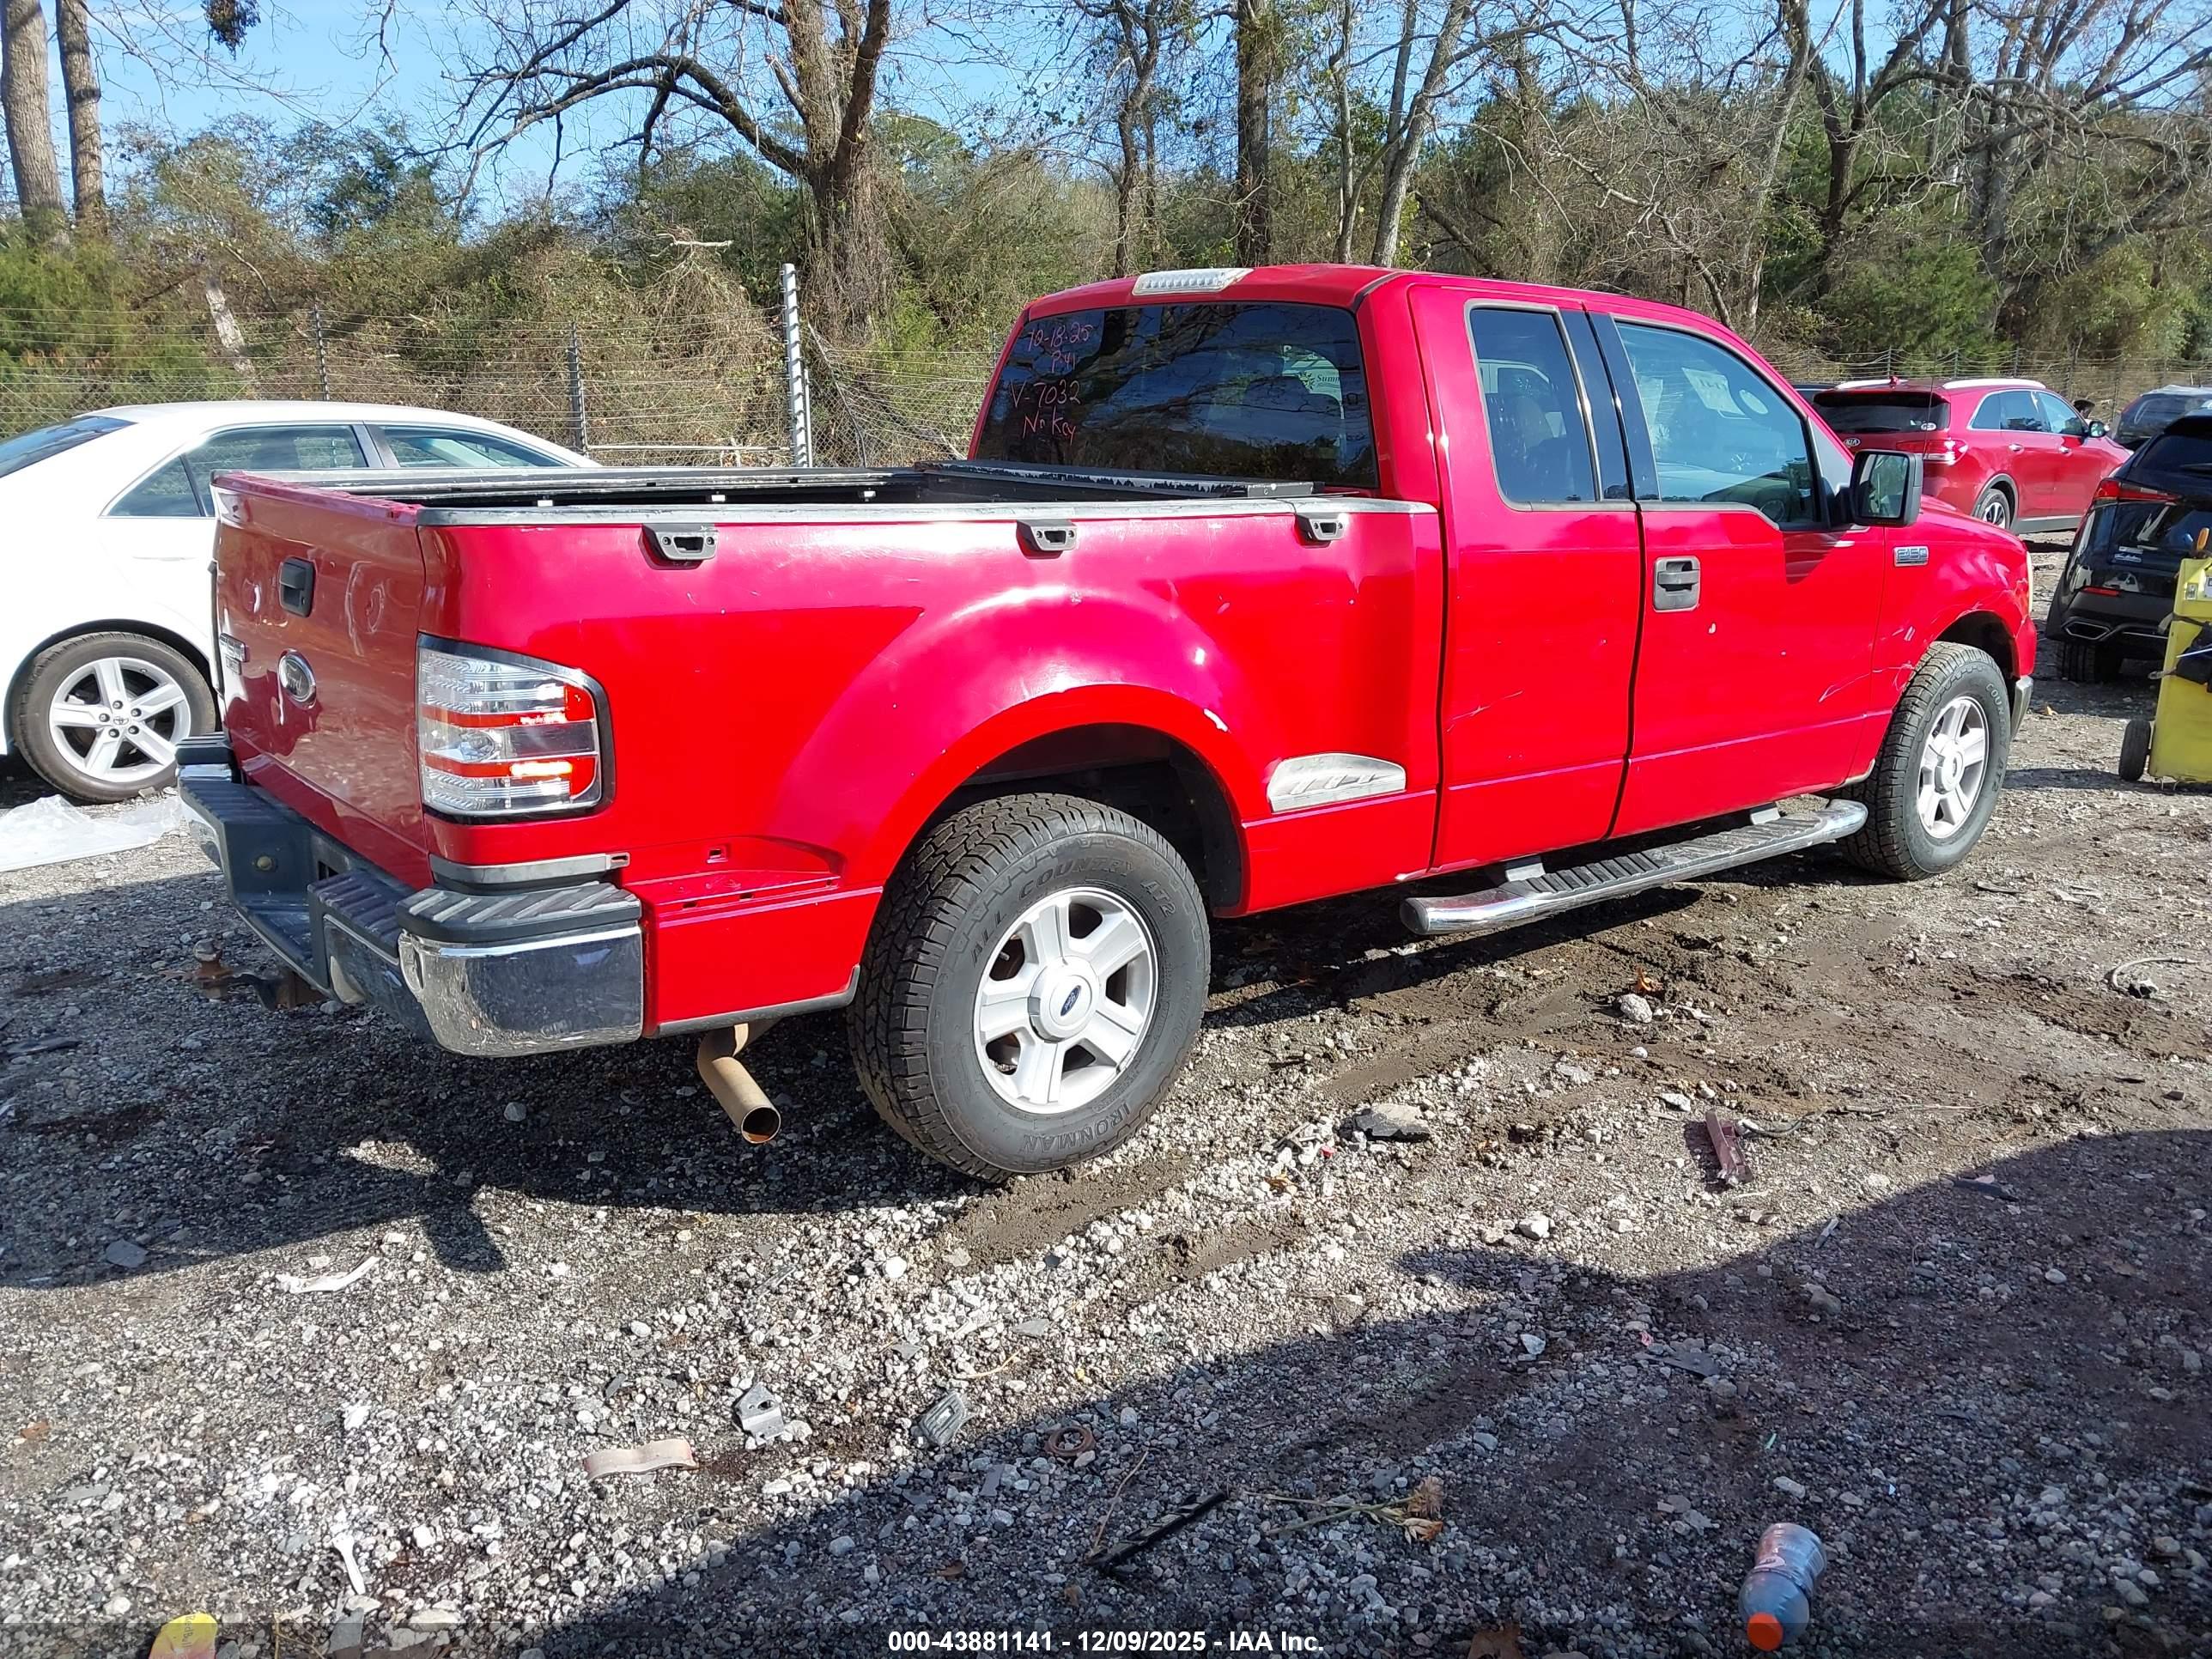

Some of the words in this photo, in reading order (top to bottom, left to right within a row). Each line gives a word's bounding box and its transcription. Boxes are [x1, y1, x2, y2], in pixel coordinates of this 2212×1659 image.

[1846, 438, 1860, 447] KIA
[1018, 858, 1134, 900] COUNTRY
[1139, 878, 1177, 918] AT2
[1019, 1102, 1132, 1154] IRONMAN
